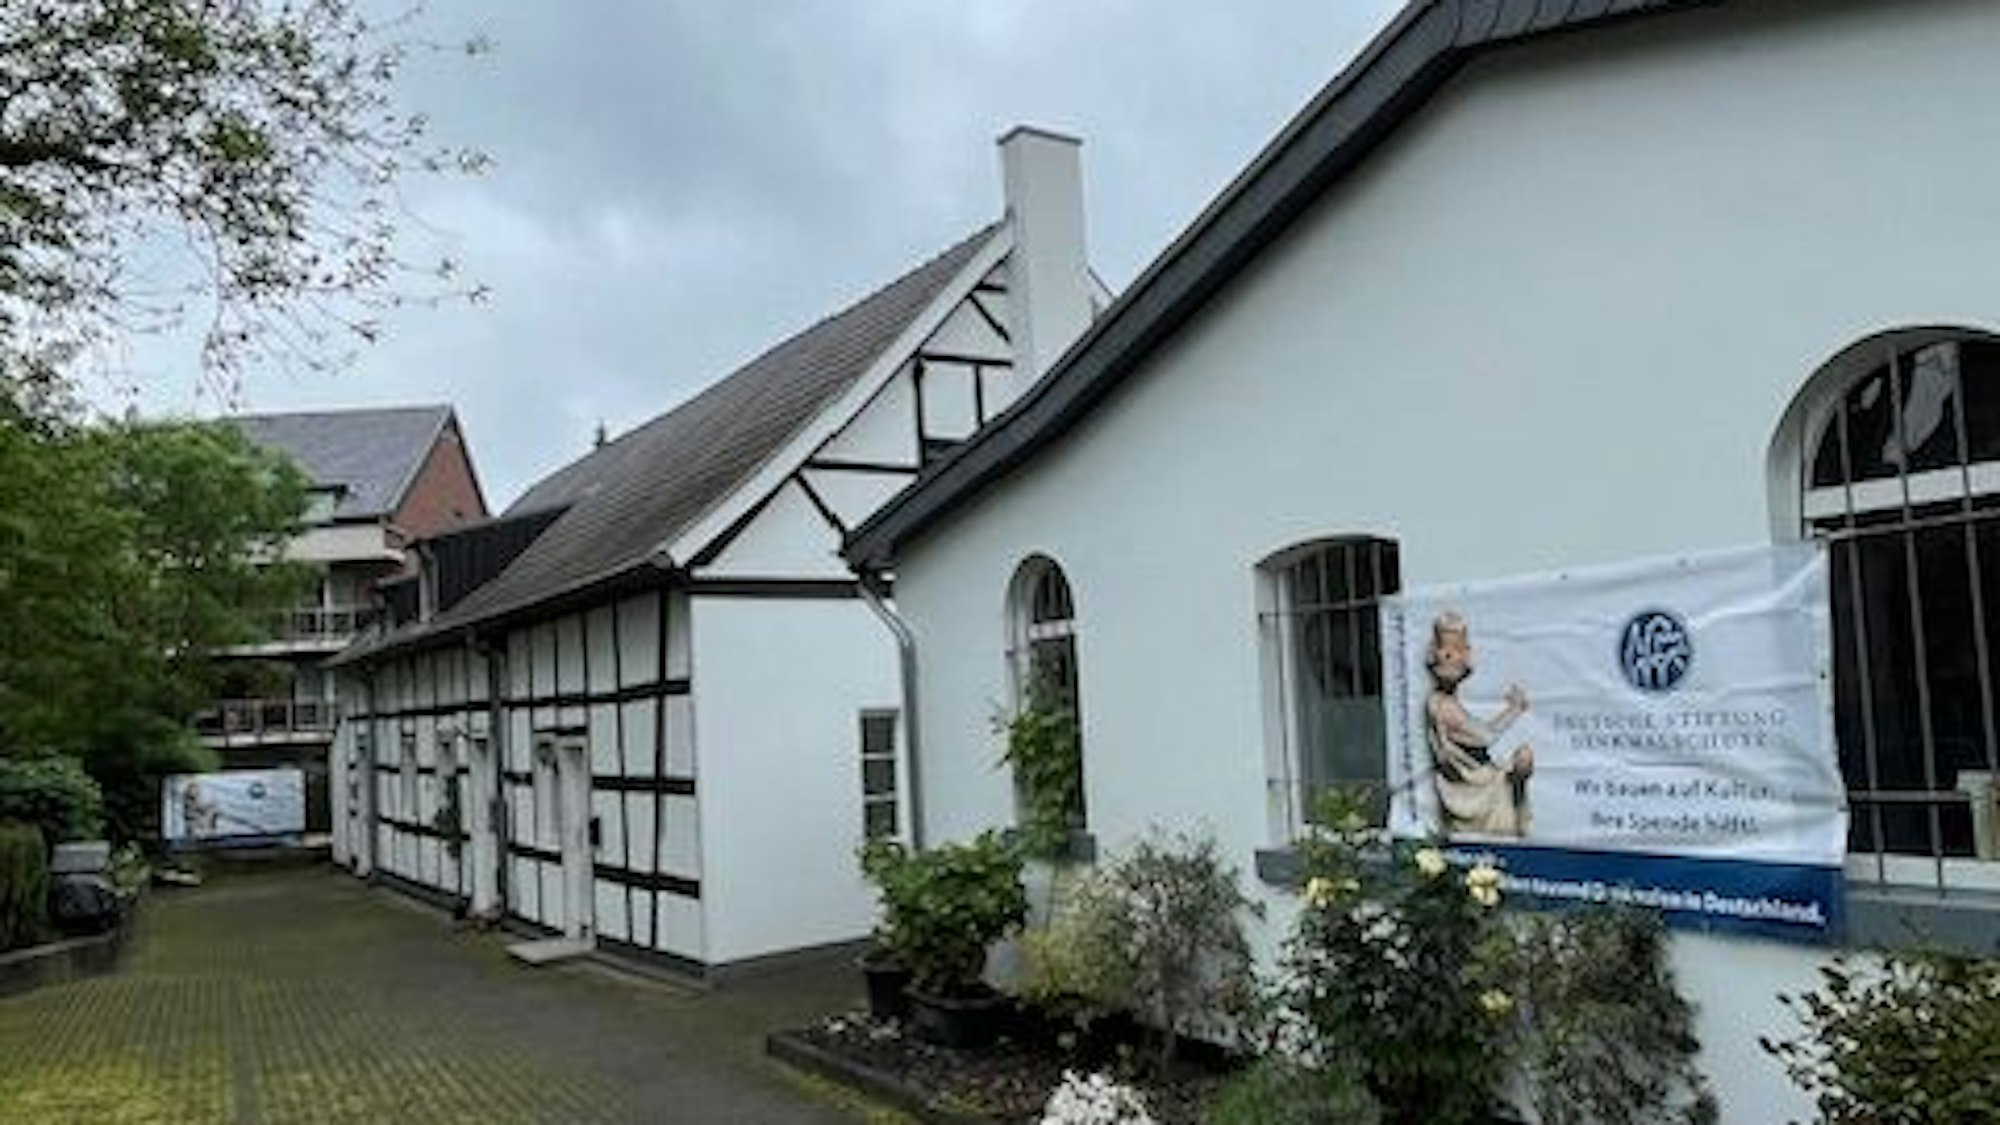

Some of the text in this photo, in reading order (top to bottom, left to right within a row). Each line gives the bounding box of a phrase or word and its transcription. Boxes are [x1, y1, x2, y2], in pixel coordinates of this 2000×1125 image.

[1665, 708, 1787, 727] STIFTUNG
[1604, 779, 1663, 797] bauen
[1666, 779, 1701, 798] auf
[1628, 812, 1700, 836] Spende
[1703, 889, 1829, 927] Deutschland.
